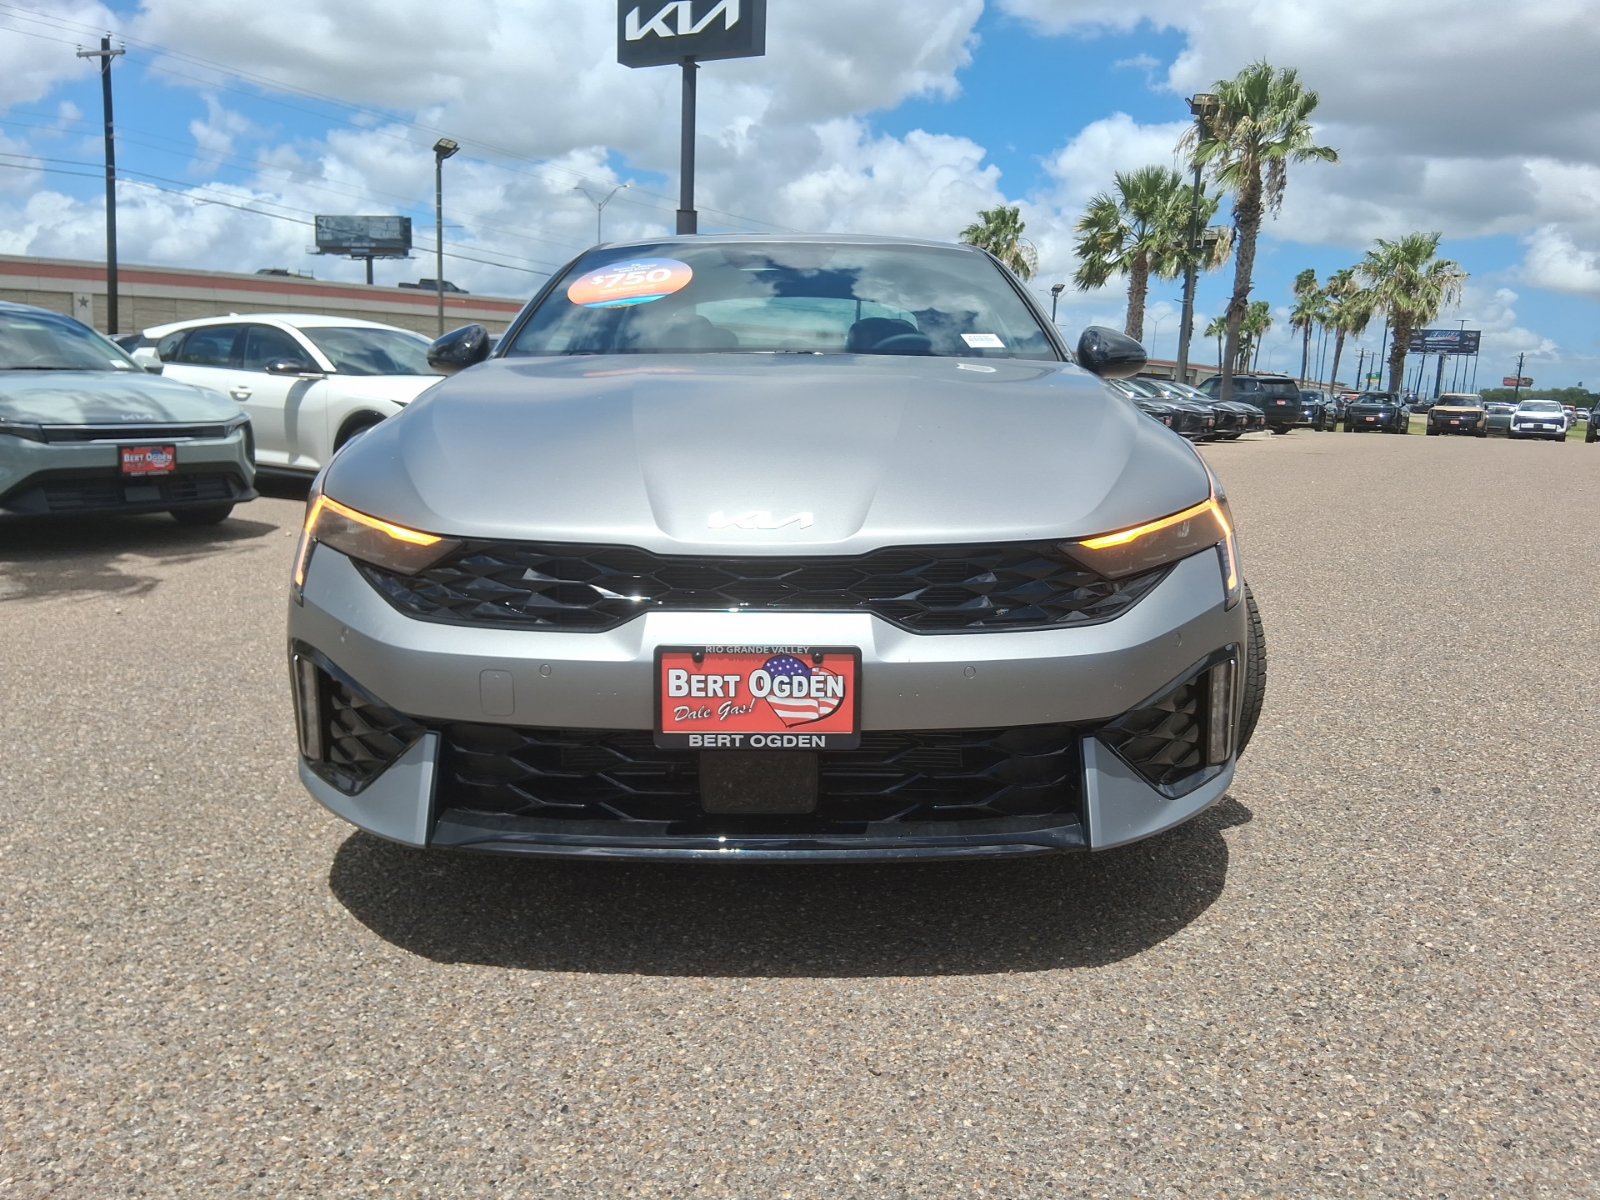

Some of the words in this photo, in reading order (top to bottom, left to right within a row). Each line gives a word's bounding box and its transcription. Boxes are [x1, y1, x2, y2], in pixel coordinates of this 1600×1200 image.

[625, 0, 739, 41] KIA
[591, 268, 672, 289] $750
[708, 510, 814, 530] KIA
[705, 645, 723, 654] RIO
[726, 645, 770, 654] GRANDE
[771, 646, 810, 654] VALLEY
[668, 668, 741, 698] BERT
[748, 668, 844, 698] OGDEN
[673, 705, 712, 721] Dale
[717, 697, 756, 721] Gas!
[688, 734, 744, 747] BERT
[749, 734, 826, 748] OGDEN
